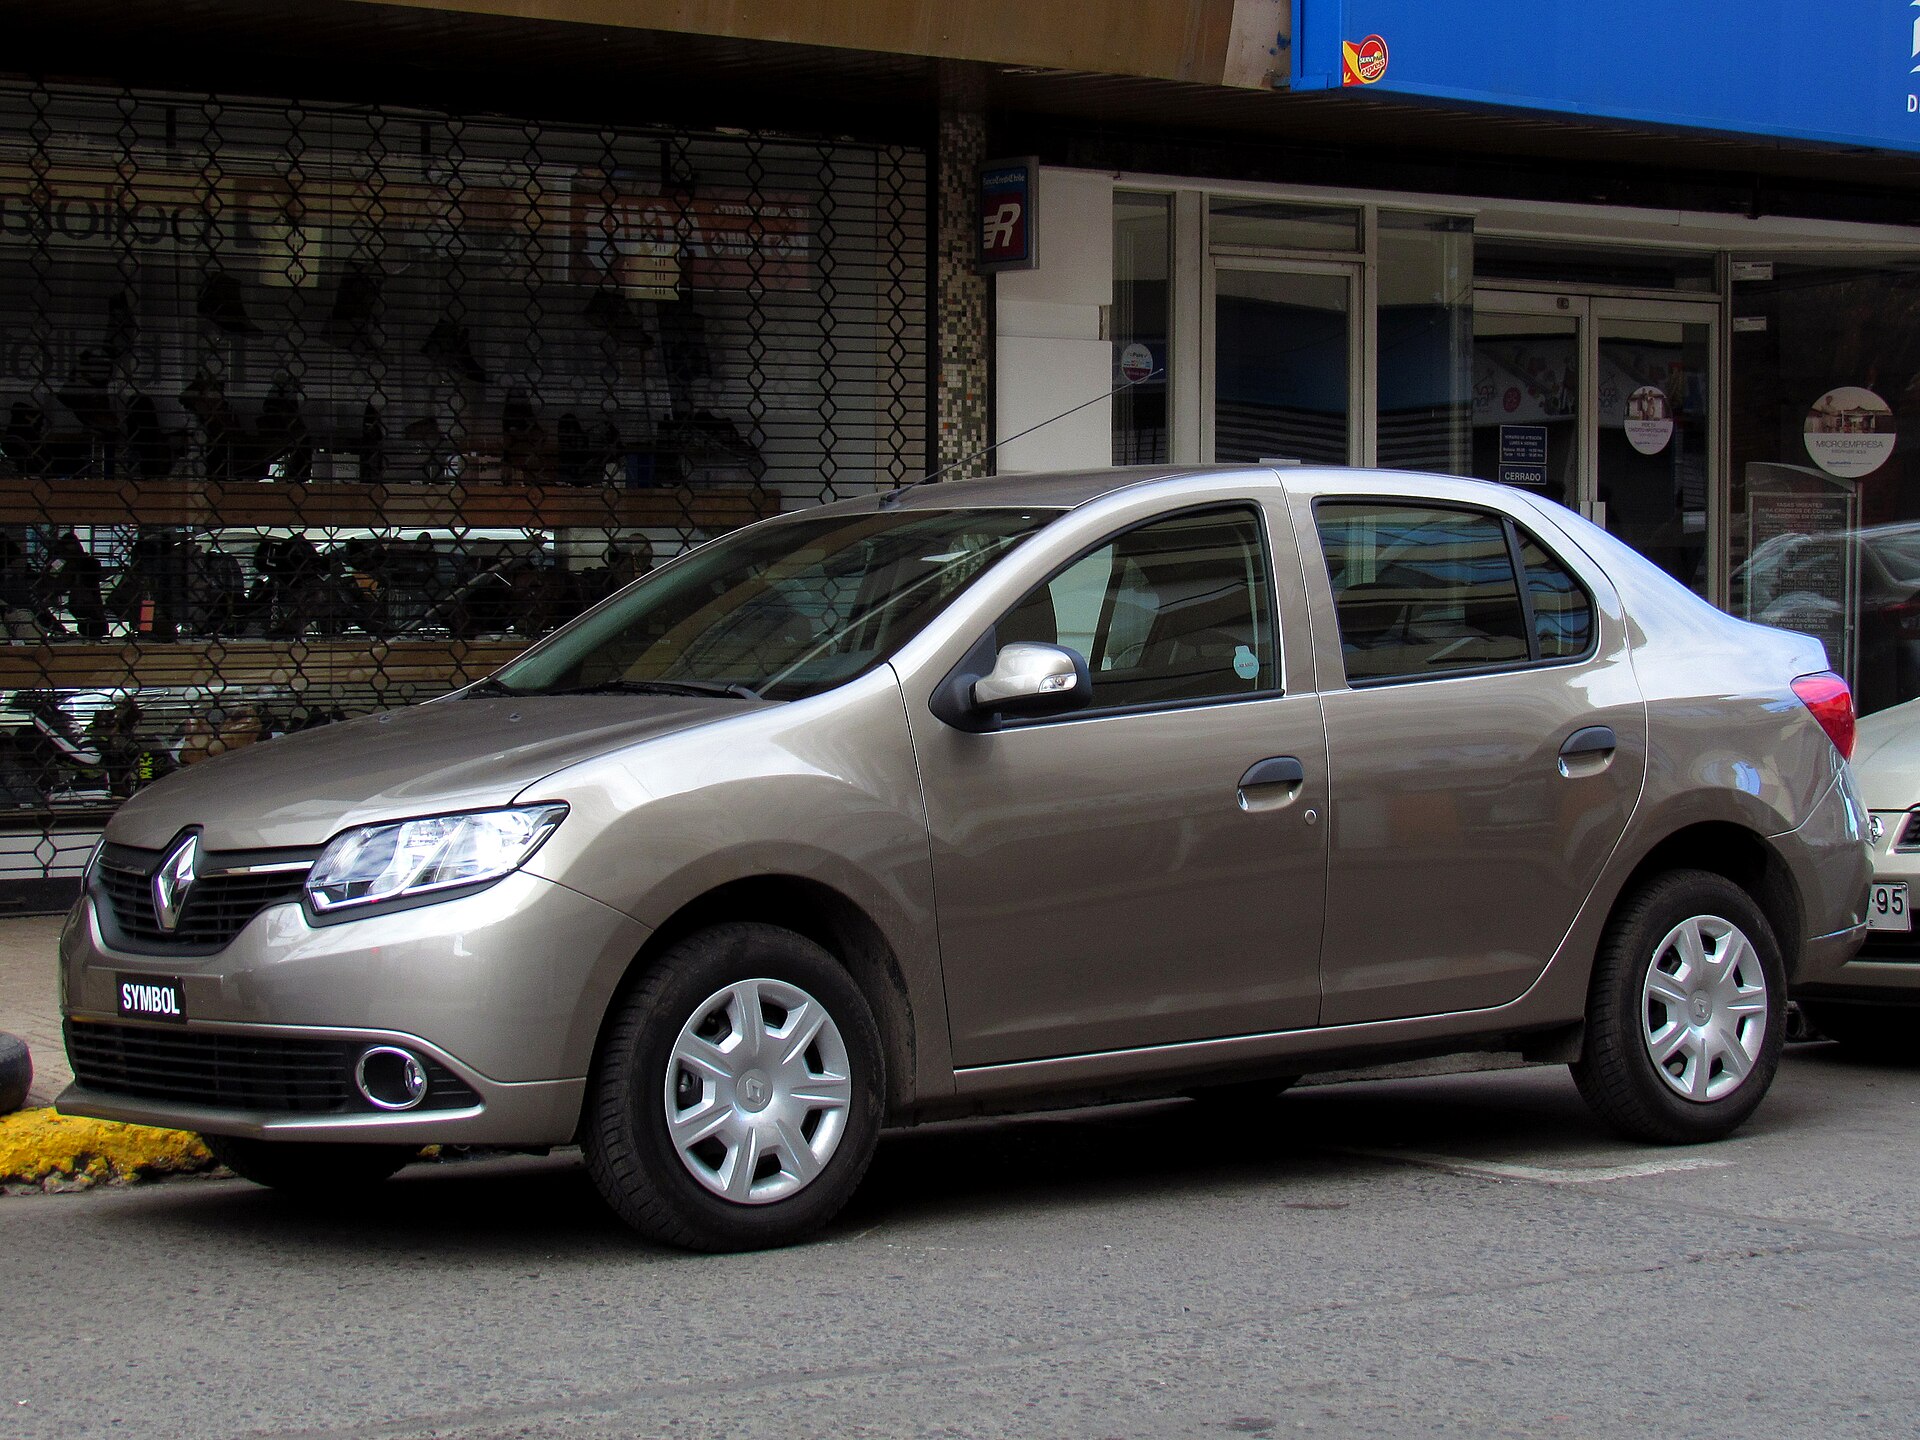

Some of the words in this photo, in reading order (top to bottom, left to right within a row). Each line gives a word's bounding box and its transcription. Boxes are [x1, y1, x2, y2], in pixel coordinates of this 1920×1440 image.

[1815, 440, 1884, 448] MICROEMPRESA
[1504, 472, 1541, 482] CERRADO
[121, 983, 181, 1015] SYMBOL
